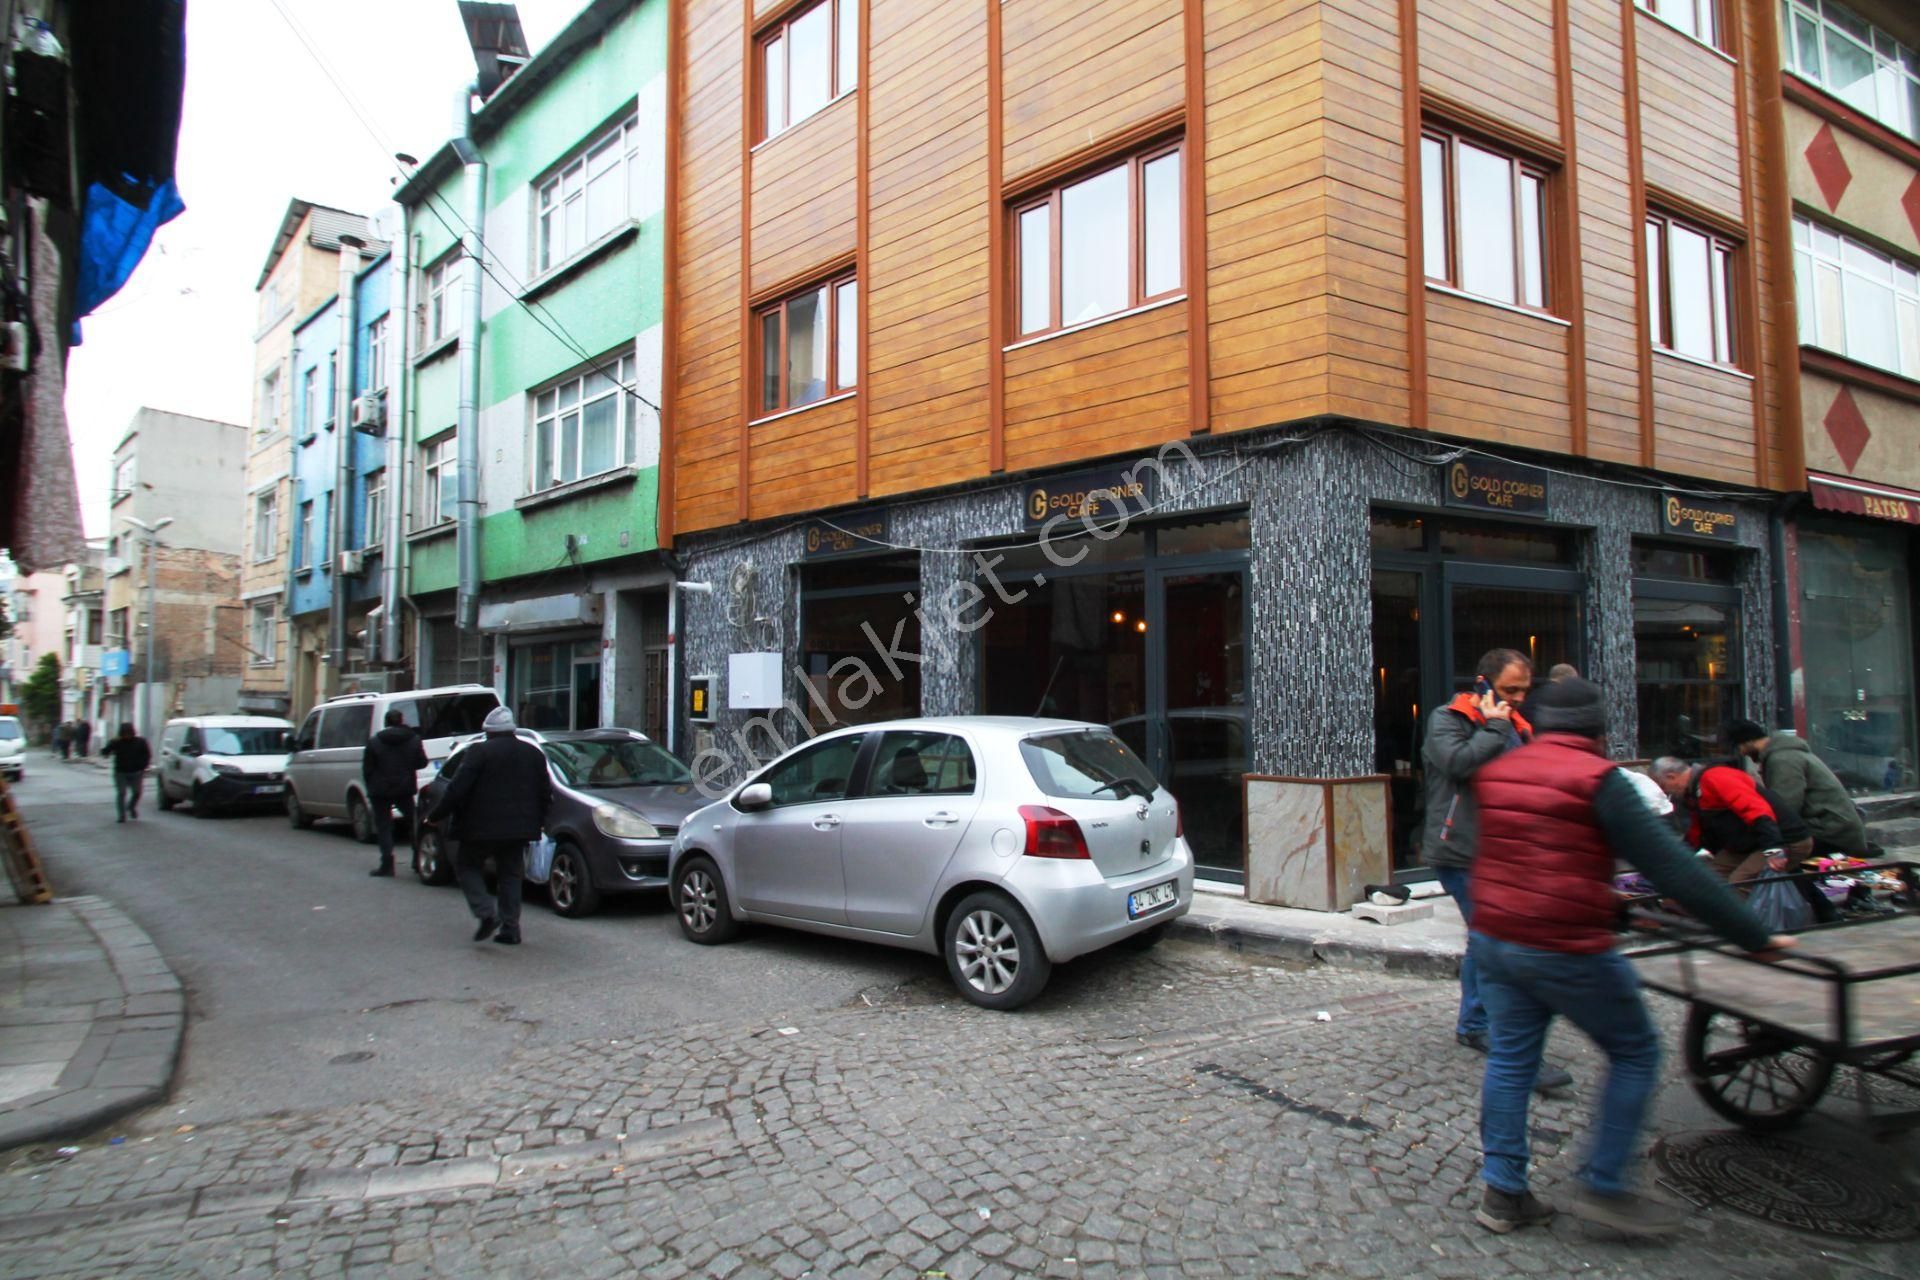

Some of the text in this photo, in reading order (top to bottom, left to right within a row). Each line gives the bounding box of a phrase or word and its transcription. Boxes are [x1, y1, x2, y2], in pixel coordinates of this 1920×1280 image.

[1470, 475, 1544, 499] GOLD CORNER
[1049, 492, 1085, 509] GOLD
[1863, 495, 1908, 519] PATSO
[1681, 507, 1735, 526] GOLD CORNER
[1133, 893, 1144, 911] 34
[1146, 888, 1161, 905] ZNC
